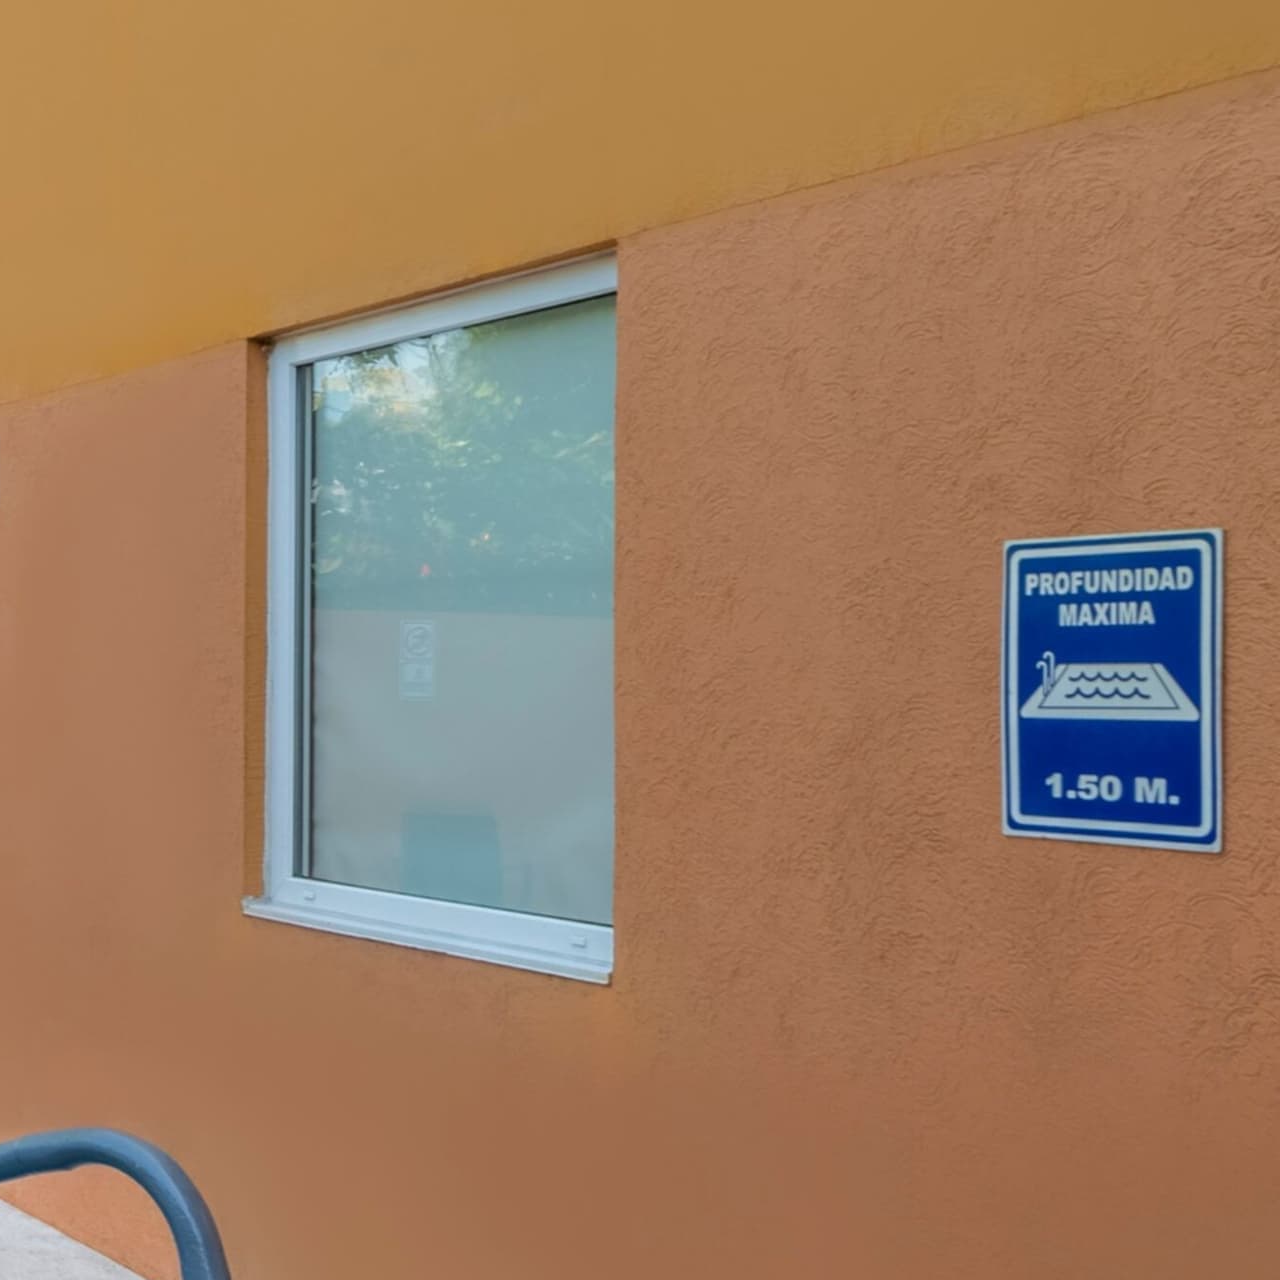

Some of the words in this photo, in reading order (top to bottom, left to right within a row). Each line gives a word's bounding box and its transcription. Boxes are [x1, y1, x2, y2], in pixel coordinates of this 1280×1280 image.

[1024, 566, 1194, 596] PROFUNDIDAD
[1058, 601, 1156, 627] MAXIMA
[1044, 772, 1123, 802] 1.50
[1134, 776, 1180, 805] M.
